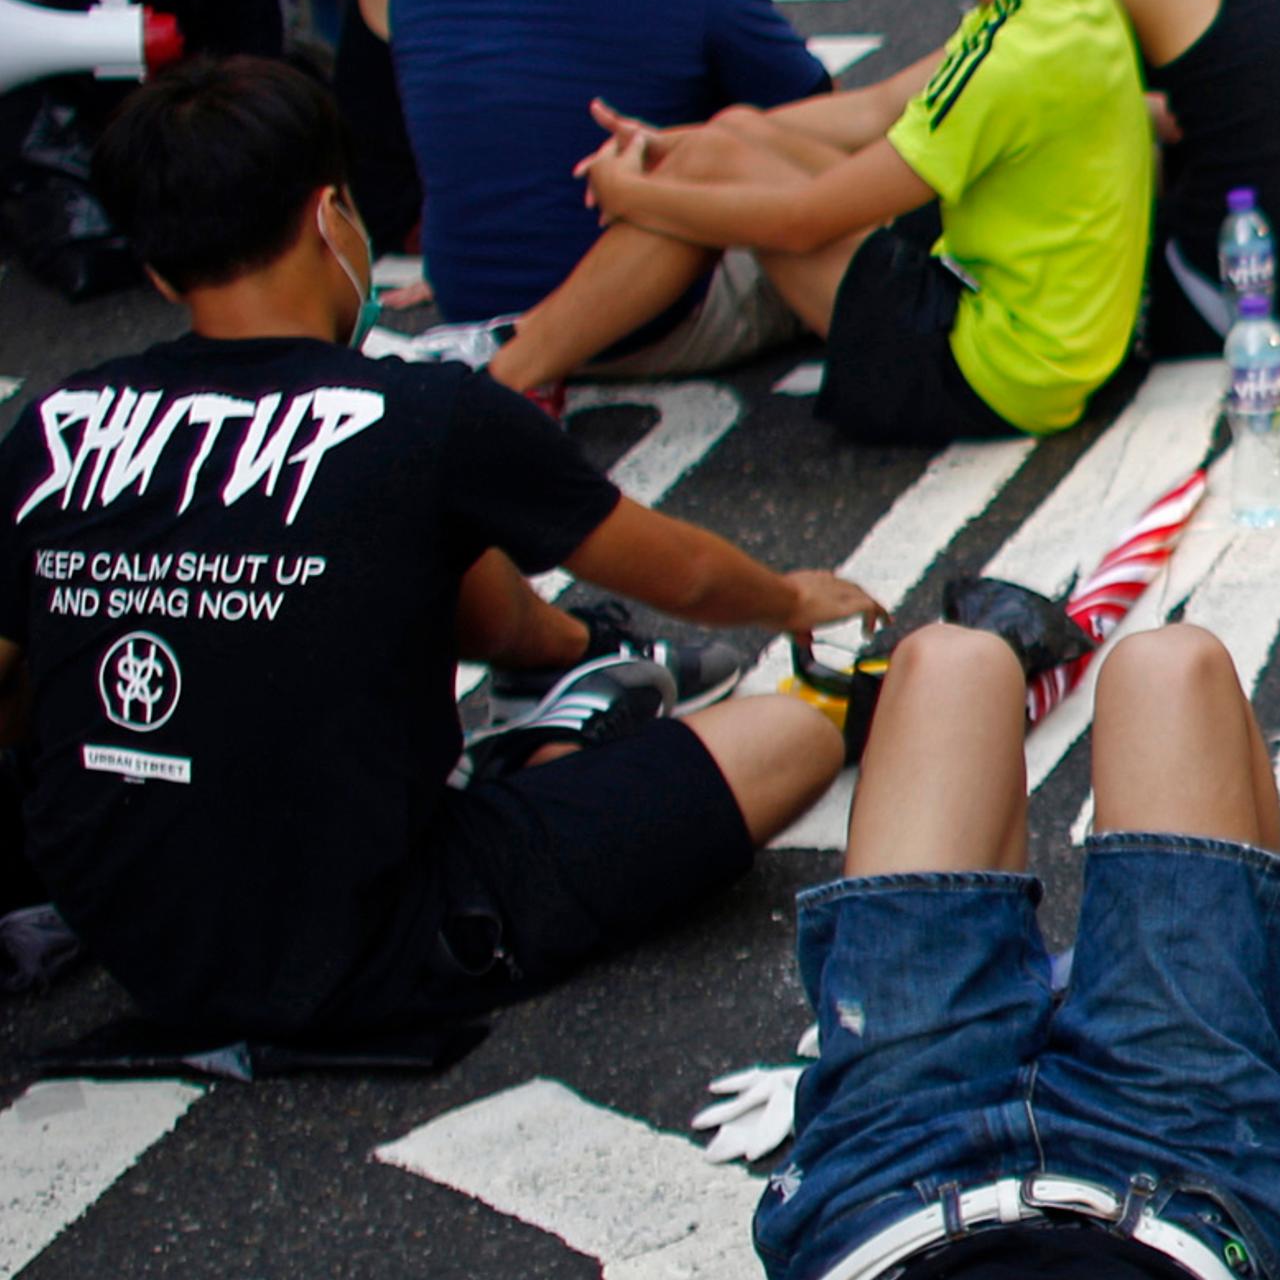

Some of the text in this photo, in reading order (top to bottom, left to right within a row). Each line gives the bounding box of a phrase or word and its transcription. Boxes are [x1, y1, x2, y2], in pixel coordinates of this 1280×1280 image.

[36, 551, 326, 585] KEEP CALM SHUT UP
[50, 587, 284, 621] AND SWAG NOW
[135, 759, 185, 777] STREET
